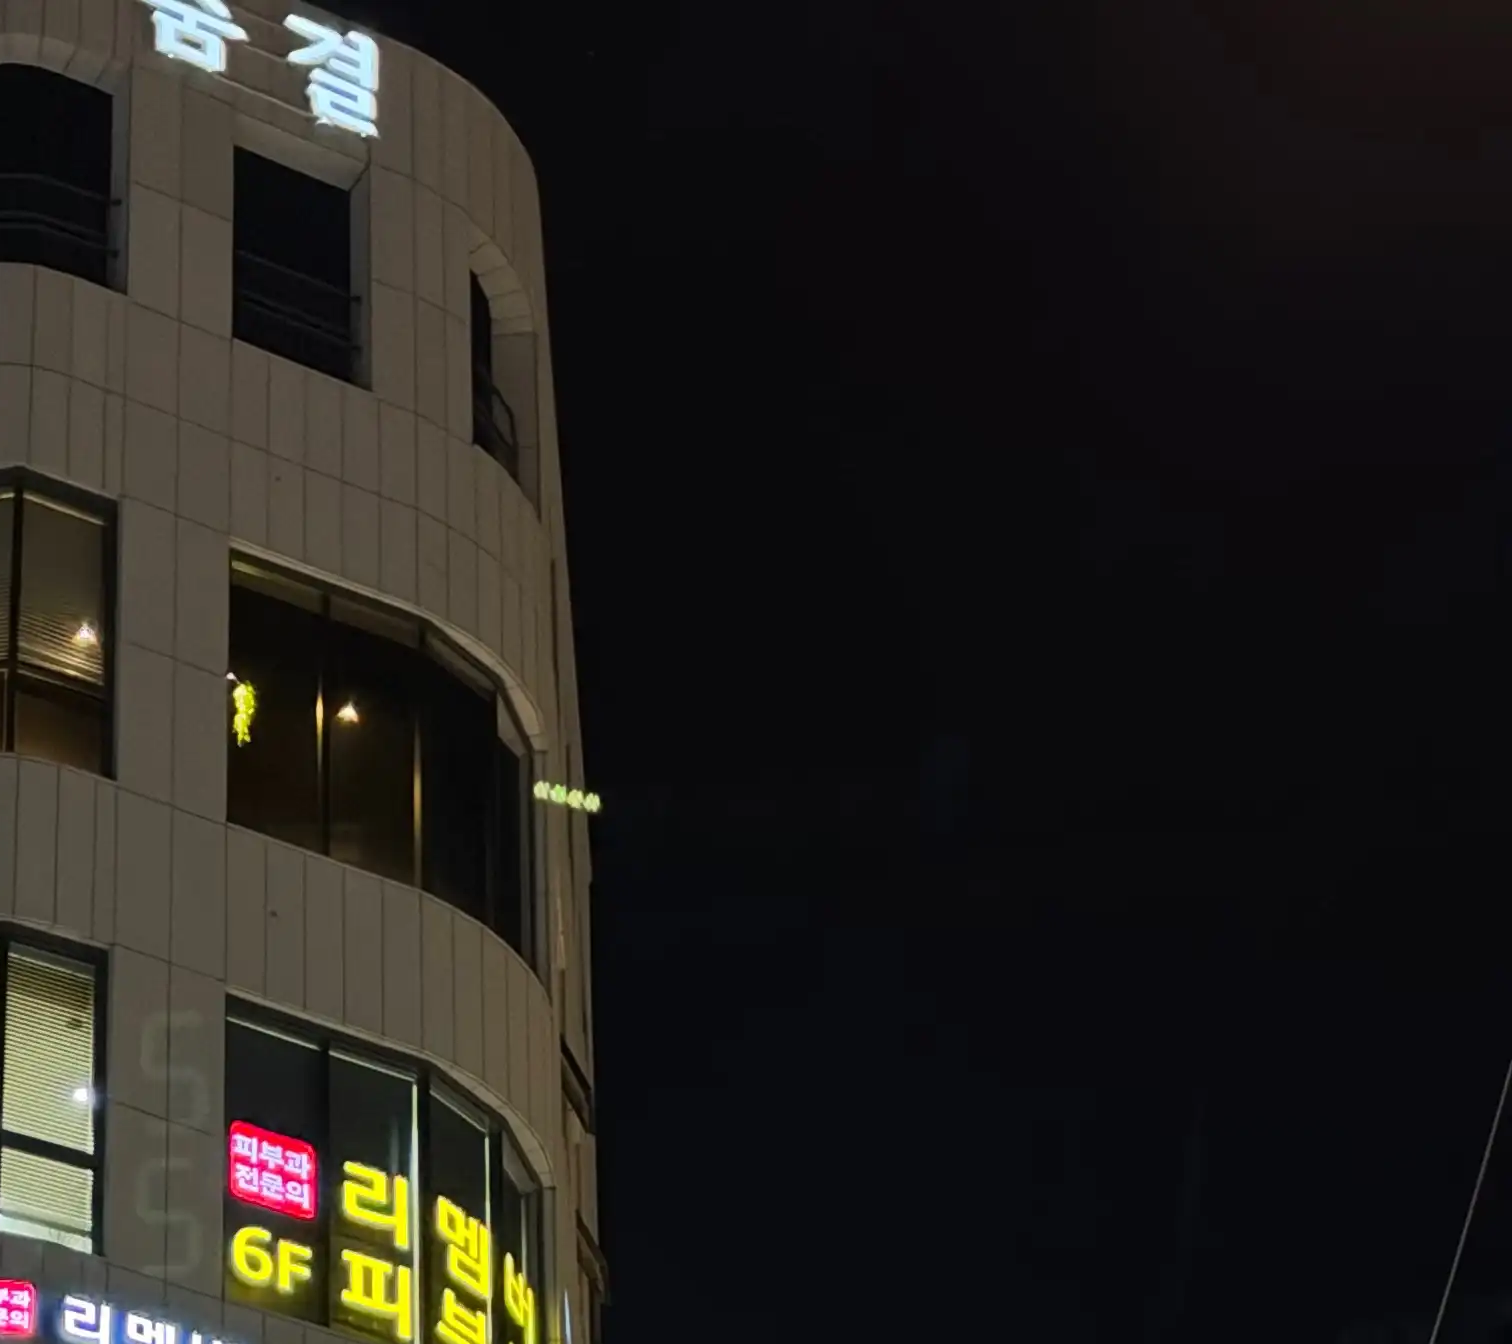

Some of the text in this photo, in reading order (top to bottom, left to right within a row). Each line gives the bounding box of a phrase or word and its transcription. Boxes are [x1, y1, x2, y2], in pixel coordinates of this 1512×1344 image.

[232, 1133, 310, 1181] 피부과
[235, 1163, 310, 1209] 전문의
[230, 1226, 313, 1294] 6F
